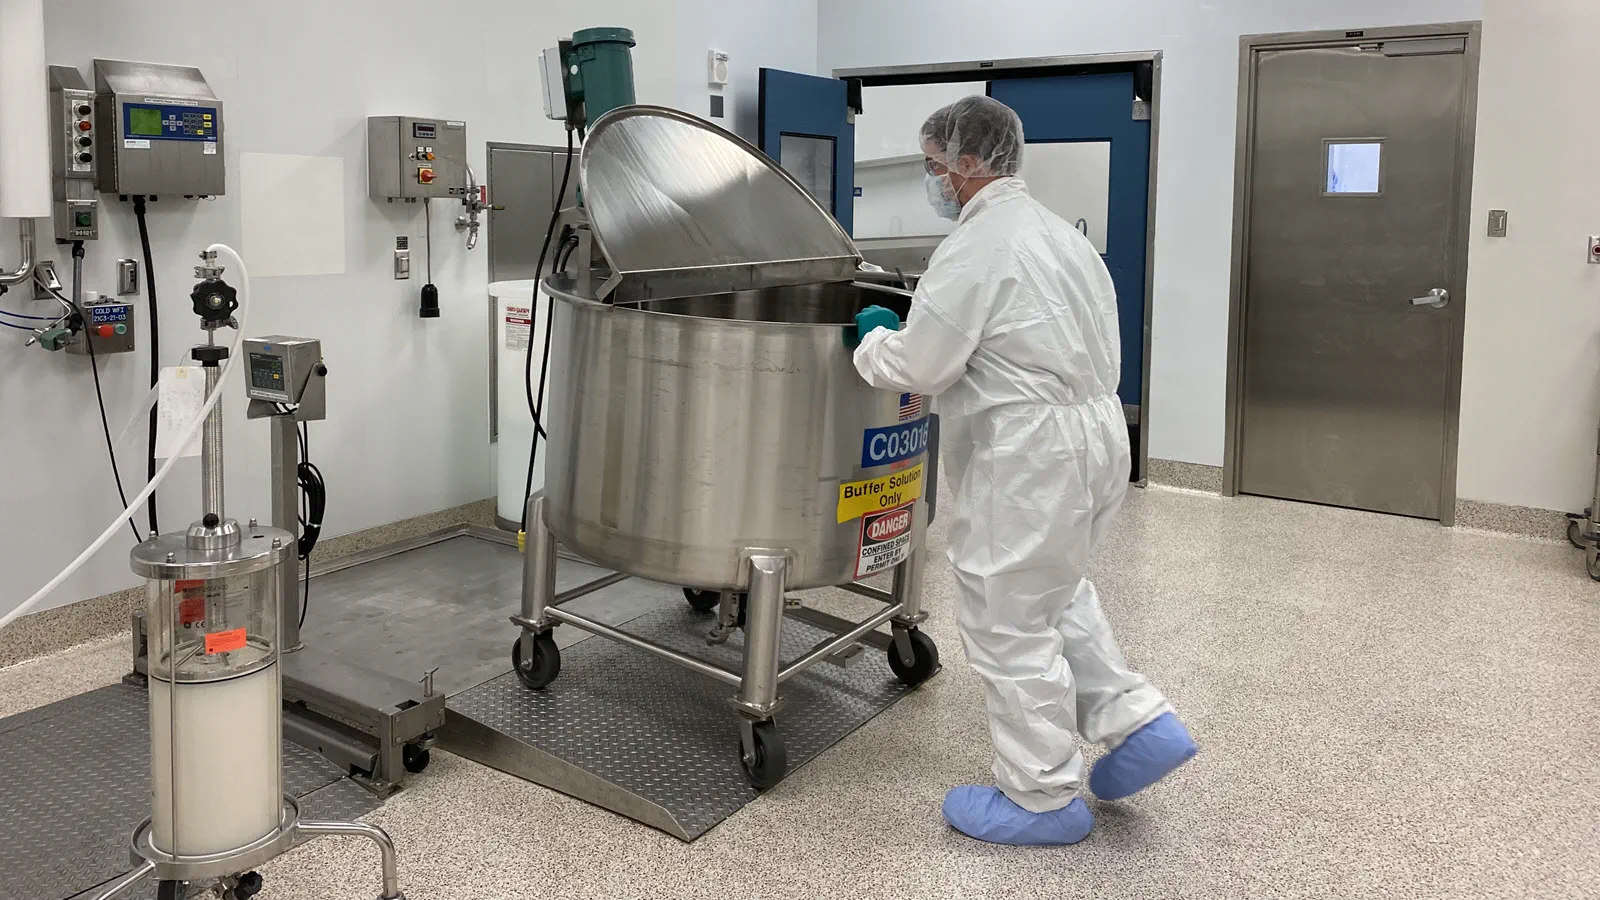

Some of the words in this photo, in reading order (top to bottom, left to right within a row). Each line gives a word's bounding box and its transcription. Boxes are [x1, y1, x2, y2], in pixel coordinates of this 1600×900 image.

[94, 307, 111, 315] COLD
[869, 422, 929, 461] C03016
[844, 482, 885, 499] Buffer
[889, 469, 921, 489] Solution
[879, 491, 902, 507] Only
[871, 513, 909, 538] DANGER
[862, 540, 895, 556] CONFINED
[895, 533, 910, 547] SPACE
[874, 550, 894, 563] ENTER
[894, 547, 902, 555] BY
[866, 559, 890, 572] PERMIT
[890, 553, 904, 565] ONLY
